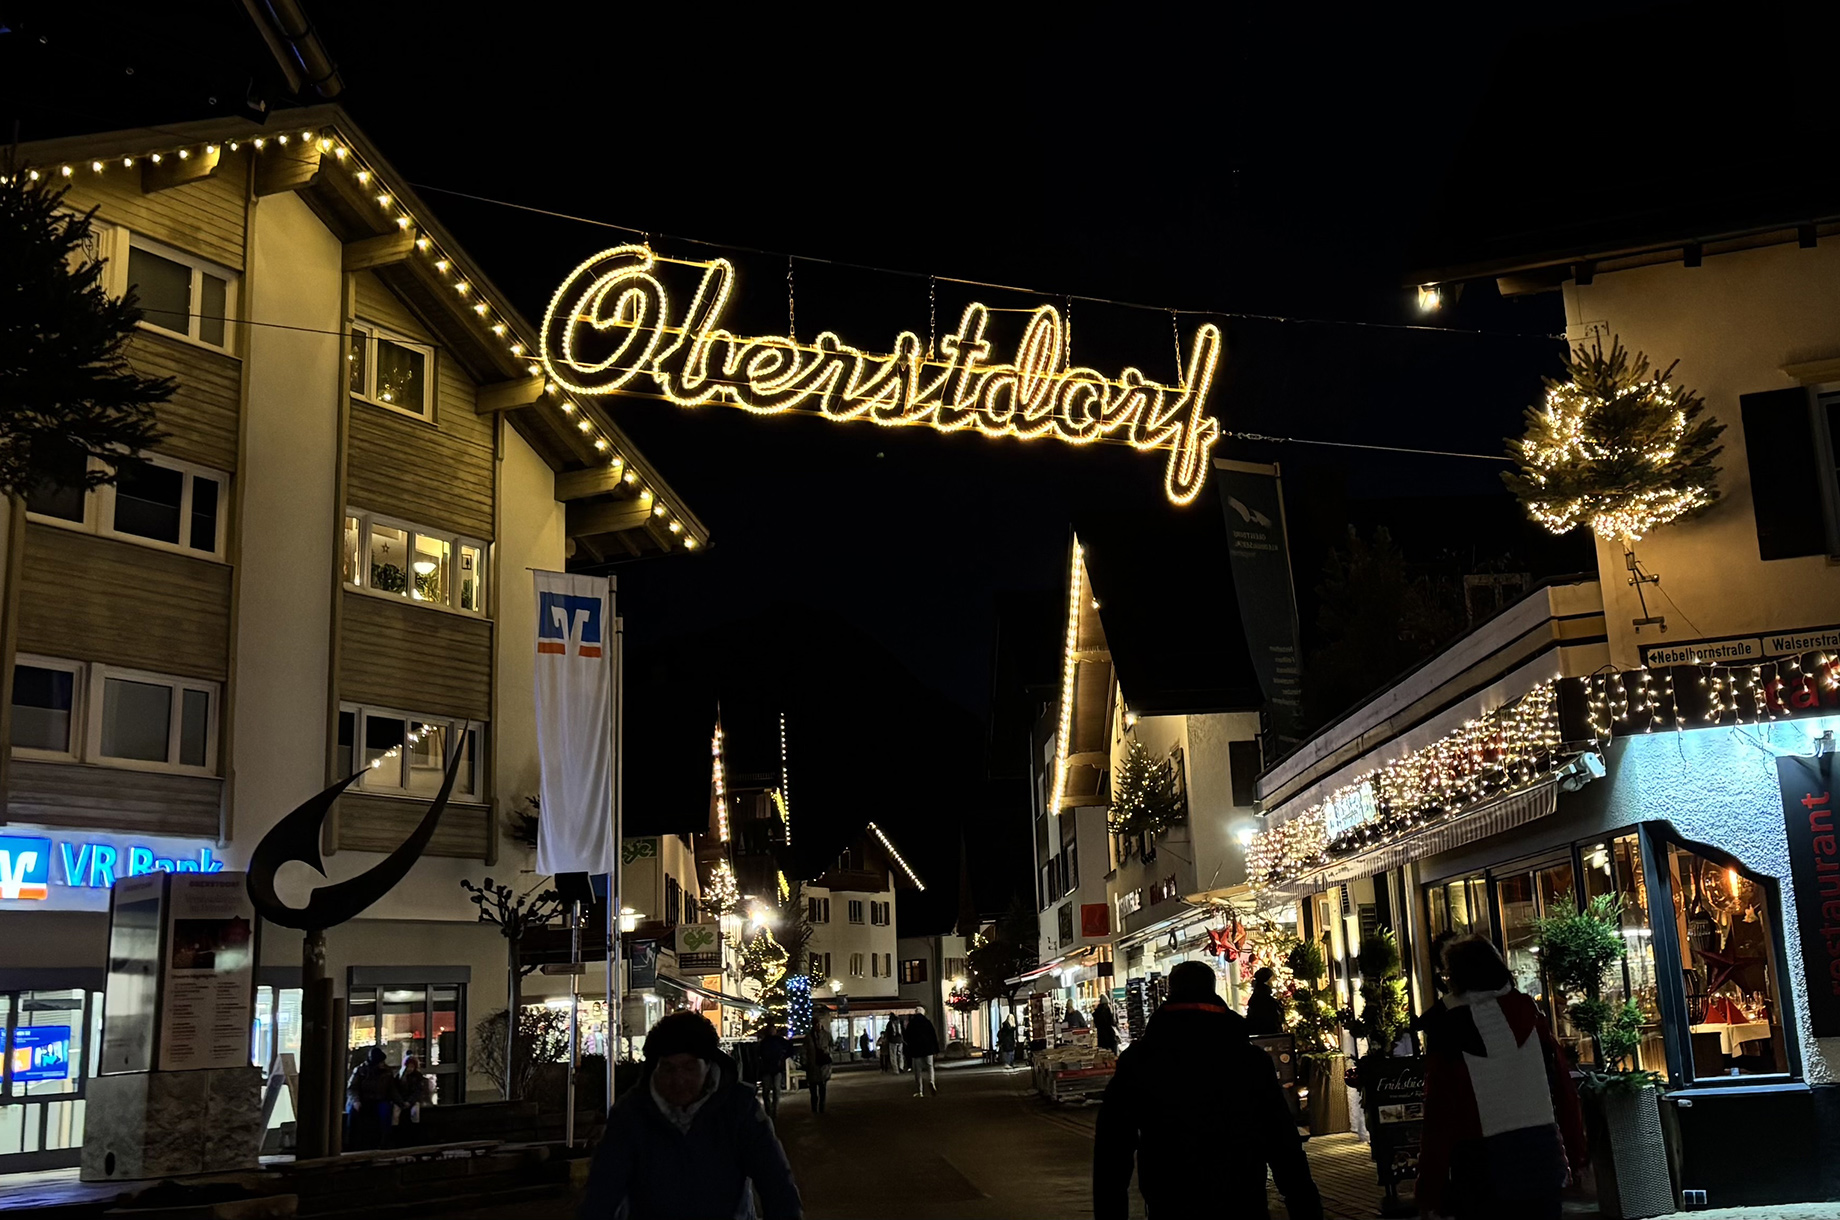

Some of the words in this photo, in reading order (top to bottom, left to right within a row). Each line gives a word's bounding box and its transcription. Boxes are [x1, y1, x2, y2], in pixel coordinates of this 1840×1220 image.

[540, 244, 1220, 505] Oberstdorf
[1657, 642, 1752, 664] Nebelhornstraße
[60, 842, 117, 887] VR
